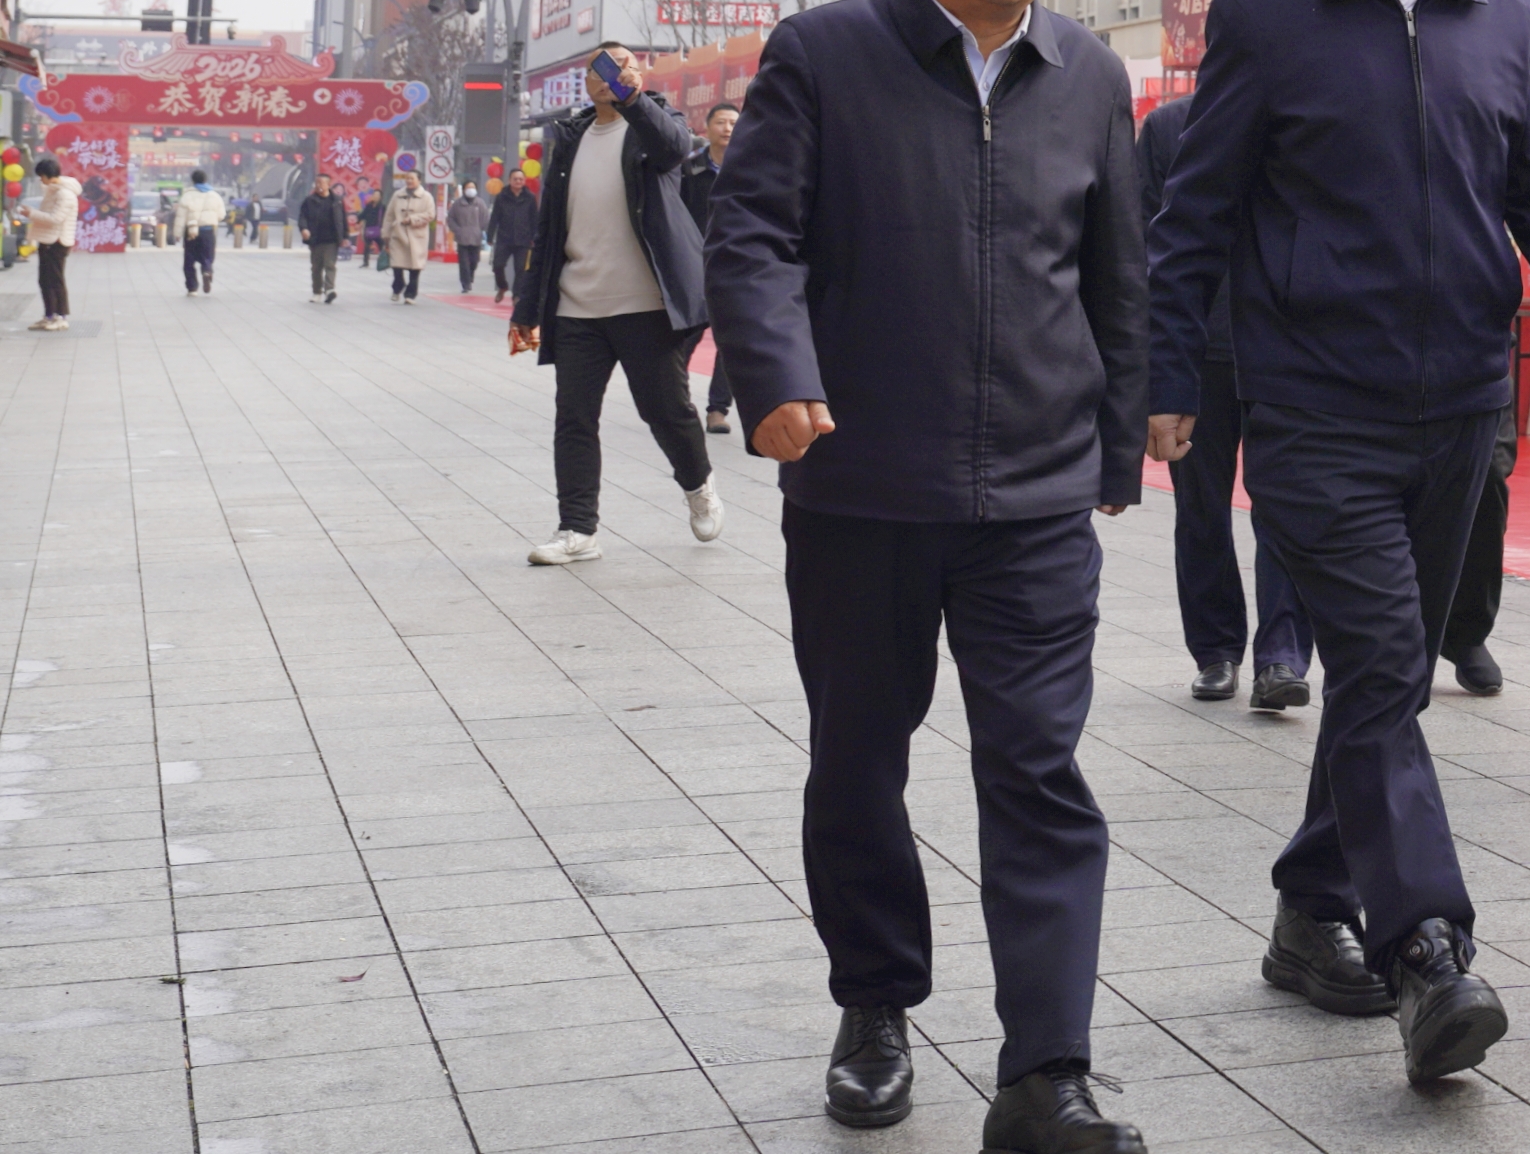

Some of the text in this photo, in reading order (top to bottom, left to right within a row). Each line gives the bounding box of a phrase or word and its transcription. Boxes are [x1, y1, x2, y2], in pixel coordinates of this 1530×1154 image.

[194, 53, 262, 83] 2026
[147, 82, 307, 121] 恭贺新春
[433, 136, 448, 149] 40
